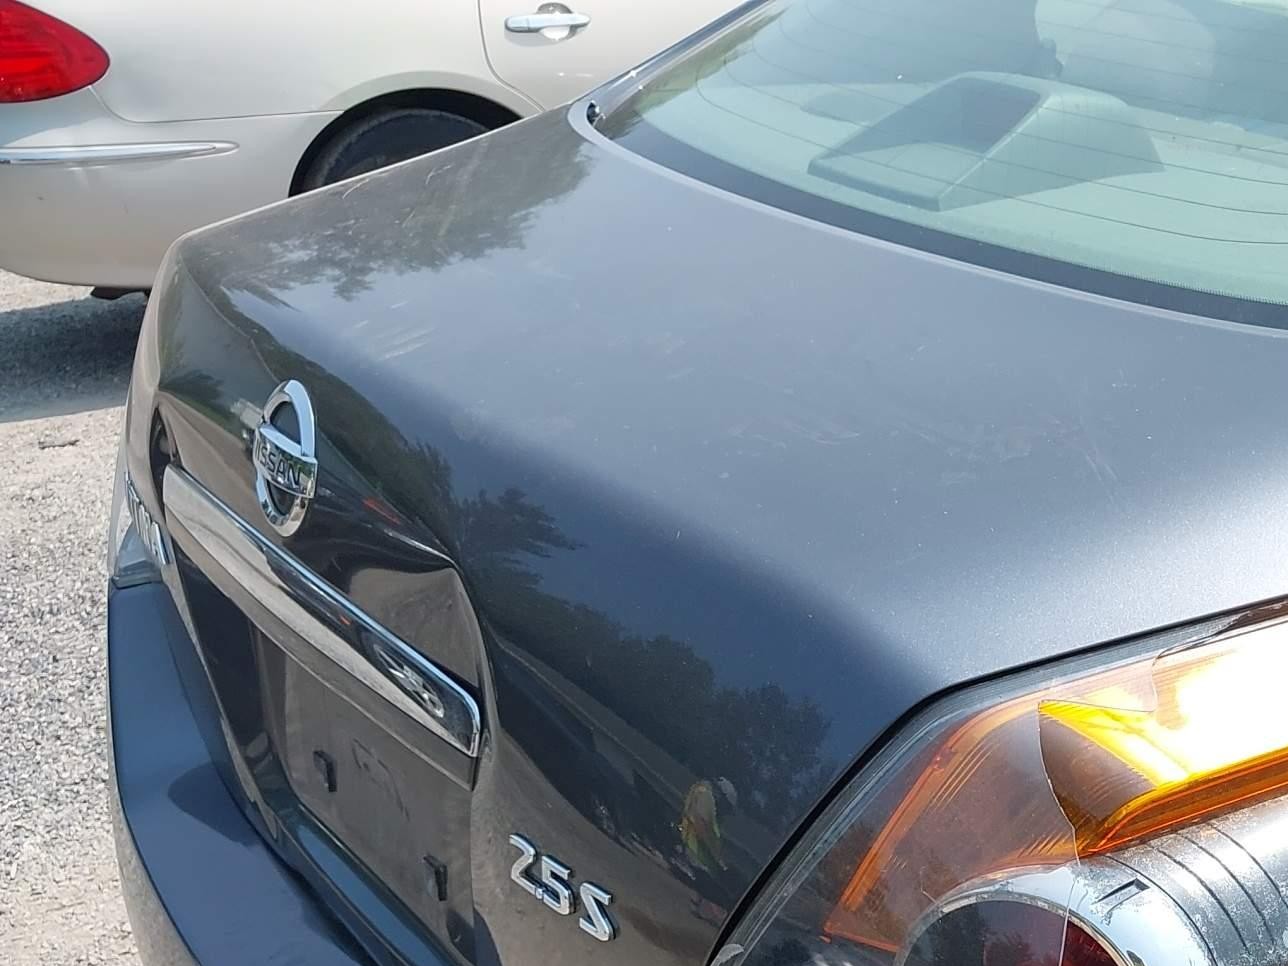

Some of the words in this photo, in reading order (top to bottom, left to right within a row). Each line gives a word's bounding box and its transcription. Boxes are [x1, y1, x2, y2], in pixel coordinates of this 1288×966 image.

[253, 436, 302, 487] ISSAN
[509, 833, 575, 915] 2.5
[579, 882, 615, 941] S
